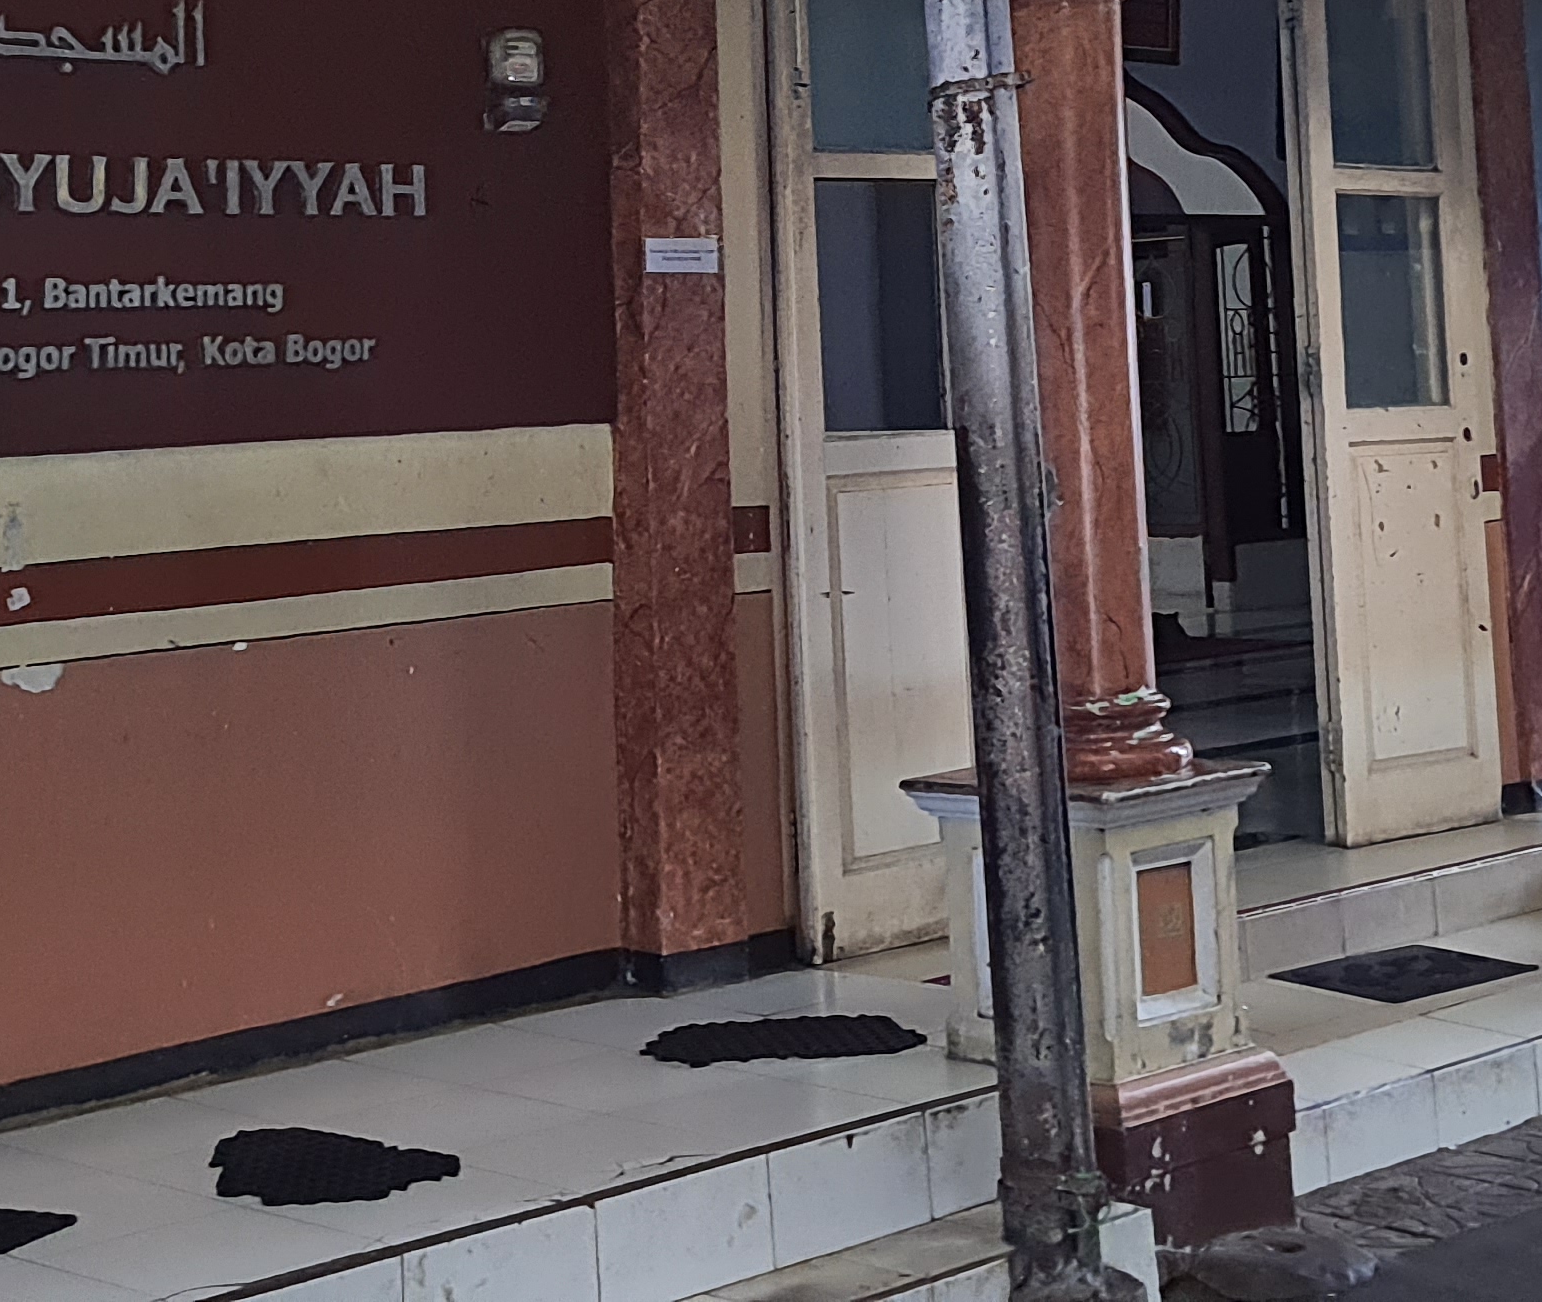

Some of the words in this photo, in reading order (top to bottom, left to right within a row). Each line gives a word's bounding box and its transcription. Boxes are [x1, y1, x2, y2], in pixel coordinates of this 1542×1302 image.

[0, 276, 33, 316] 1,
[42, 274, 285, 314] Bantarkemang
[83, 335, 184, 374] Timur,
[202, 334, 277, 367] Kota
[285, 333, 377, 370] Bogor
